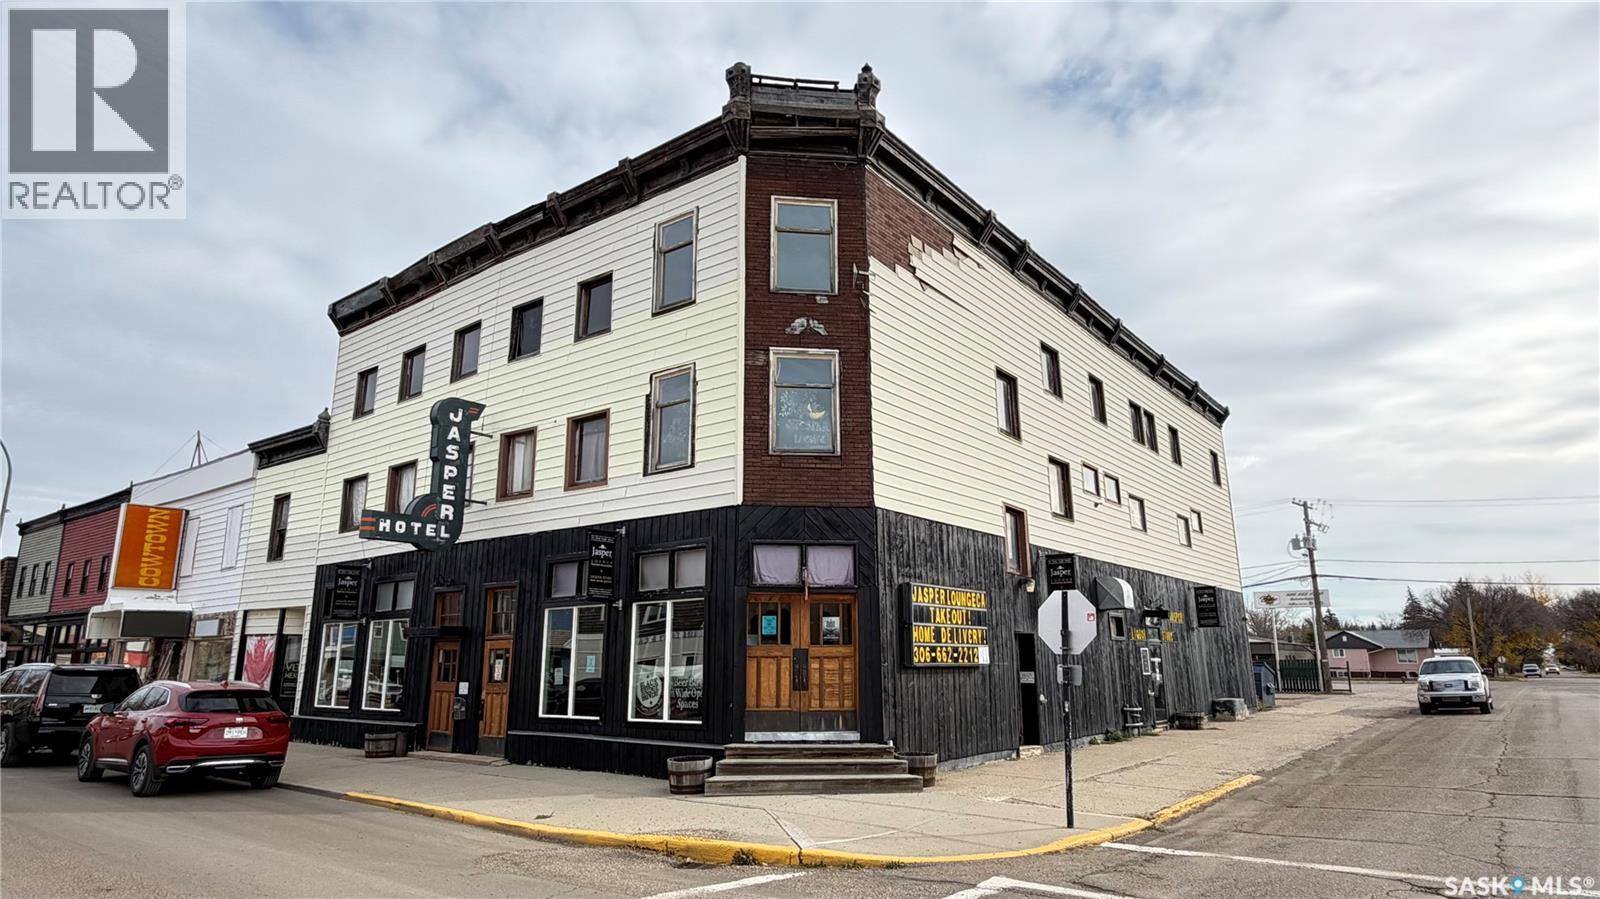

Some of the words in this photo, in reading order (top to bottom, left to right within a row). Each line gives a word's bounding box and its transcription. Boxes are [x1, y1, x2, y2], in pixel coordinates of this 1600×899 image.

[440, 408, 463, 521] JASPER
[378, 518, 450, 538] HOTEL
[138, 508, 170, 588] COWTOWN
[591, 546, 613, 559] Jasper
[1050, 568, 1072, 578] Jasper
[912, 586, 946, 605] JASPER
[929, 607, 972, 626] TAKEOUT!
[913, 626, 936, 643] HOME
[913, 646, 979, 663] 306-662-2212
